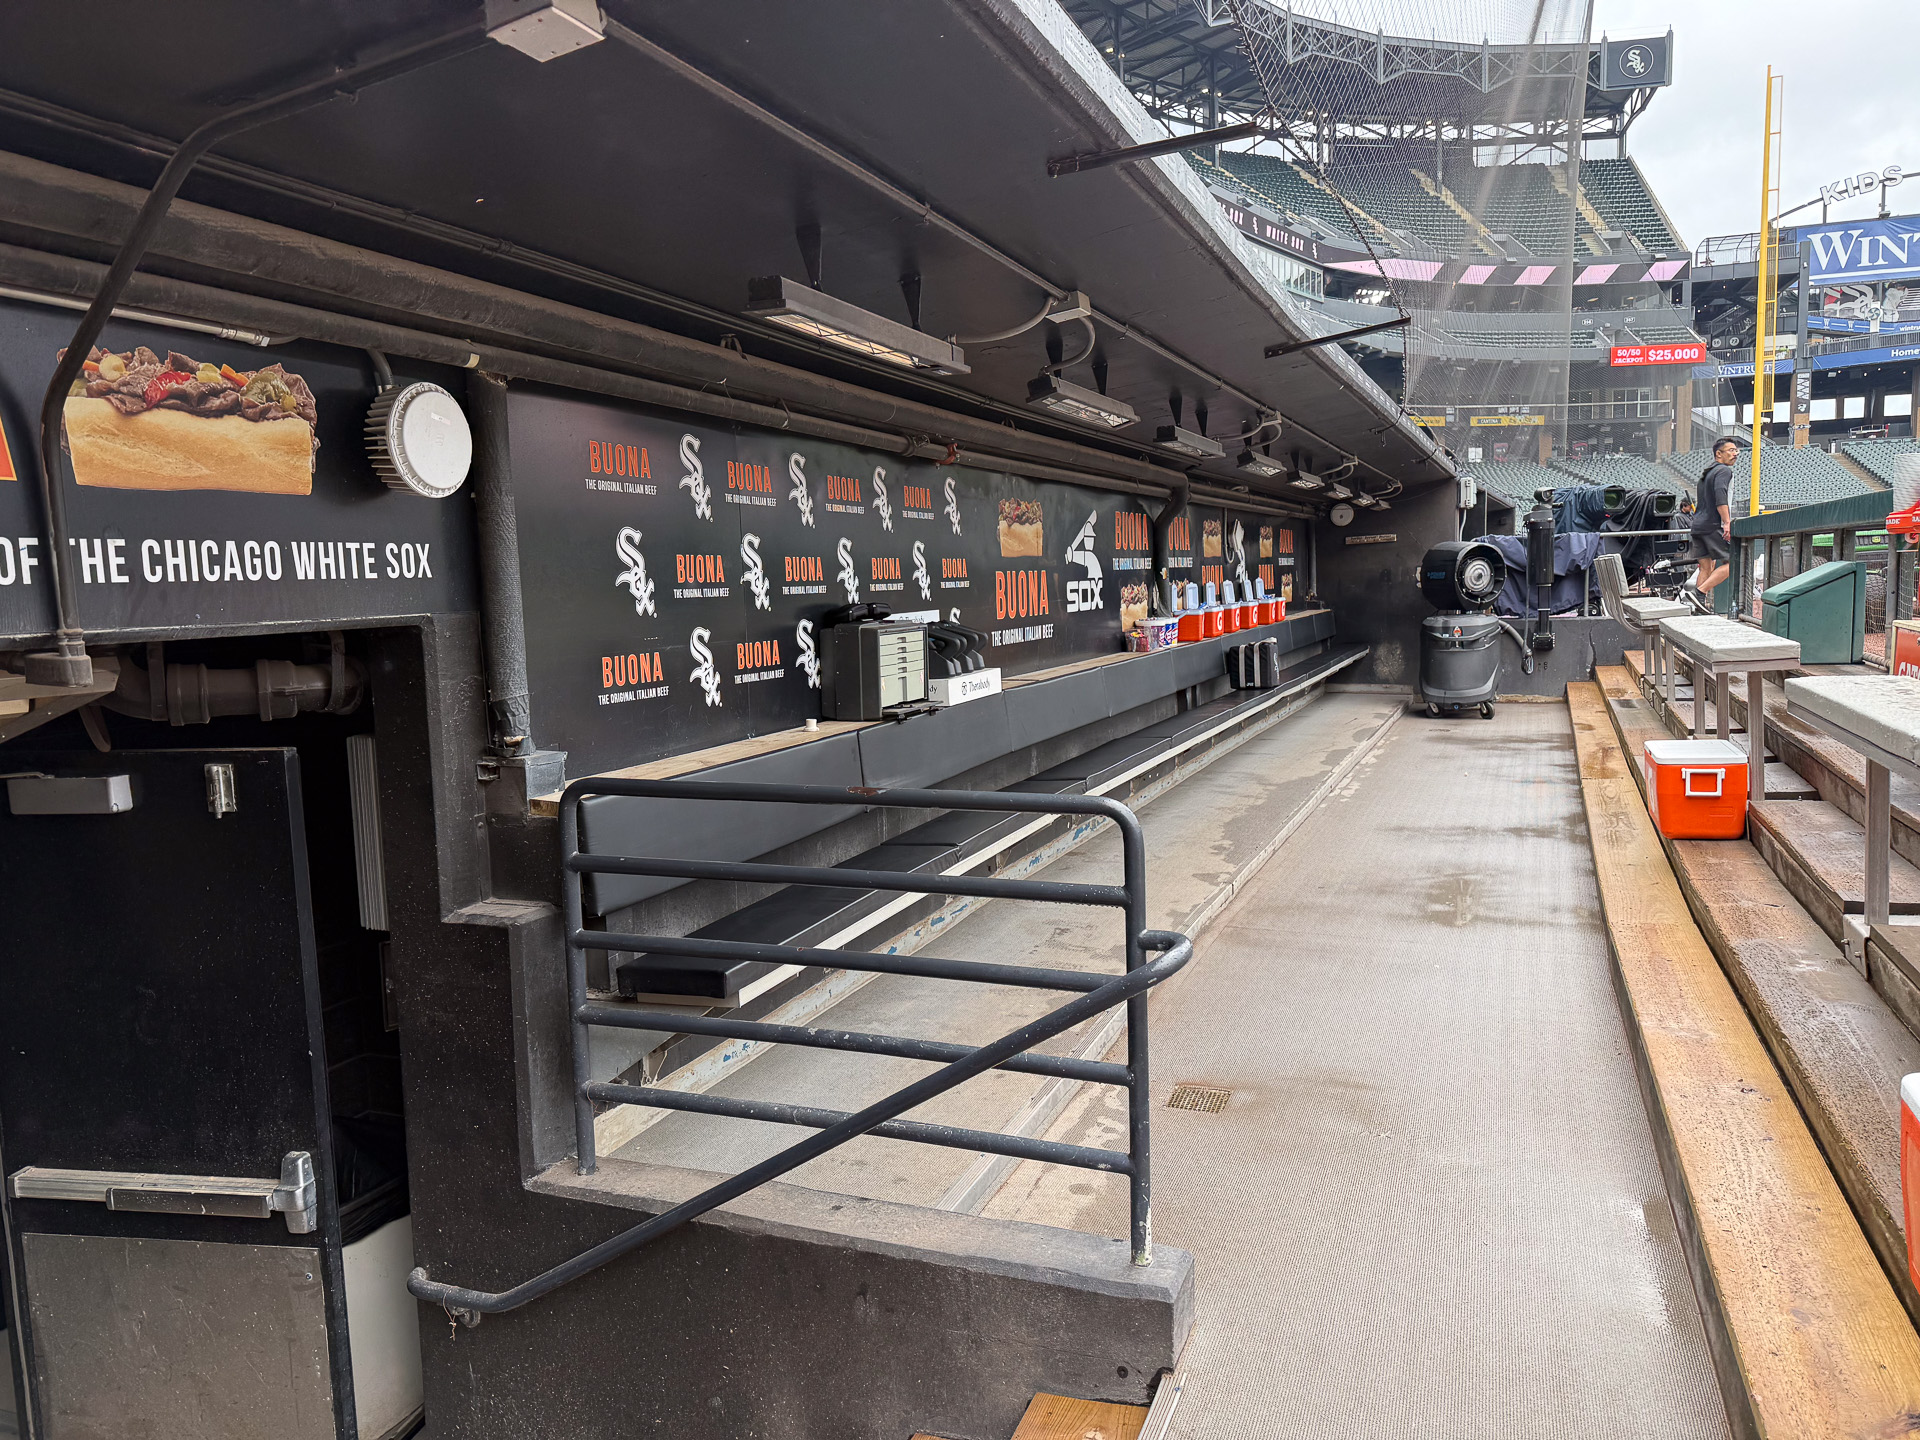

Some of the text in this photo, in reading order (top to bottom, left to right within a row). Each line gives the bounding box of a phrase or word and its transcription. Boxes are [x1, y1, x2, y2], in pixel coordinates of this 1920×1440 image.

[1820, 165, 1904, 206] KIDS
[1266, 225, 1289, 245] WHITE
[1291, 236, 1304, 251] SOX
[1807, 229, 1920, 271] WIN
[1617, 347, 1699, 361] 50/50 $25,000
[1891, 348, 1920, 357] Home
[1717, 363, 1773, 375] WINTRUT
[589, 440, 651, 479] BUONA
[585, 479, 657, 496] THE ORIGINAL ITALIAN BEEF
[727, 461, 772, 493] BUONA
[827, 475, 862, 502] BUONA
[904, 485, 932, 509] BUONA
[1115, 511, 1149, 551] BUONA
[1168, 516, 1191, 551] UONA
[0, 536, 433, 586] OF HE CHICAGO WHITE SOX
[676, 554, 725, 583] BUONA
[785, 556, 824, 582] BUONA
[871, 557, 901, 580] BUONA
[942, 558, 968, 579] BUONA
[995, 570, 1049, 620] BUONA
[1066, 579, 1104, 613] SOX
[991, 630, 1002, 647] THE
[1042, 623, 1054, 639] BEEF
[737, 640, 781, 670] BUONA
[602, 652, 664, 688] BUONA
[1898, 661, 1920, 680] GAT
[598, 685, 670, 706] THE ORIGINAL ITALIAN BEEF
[969, 678, 991, 693] Therabody
